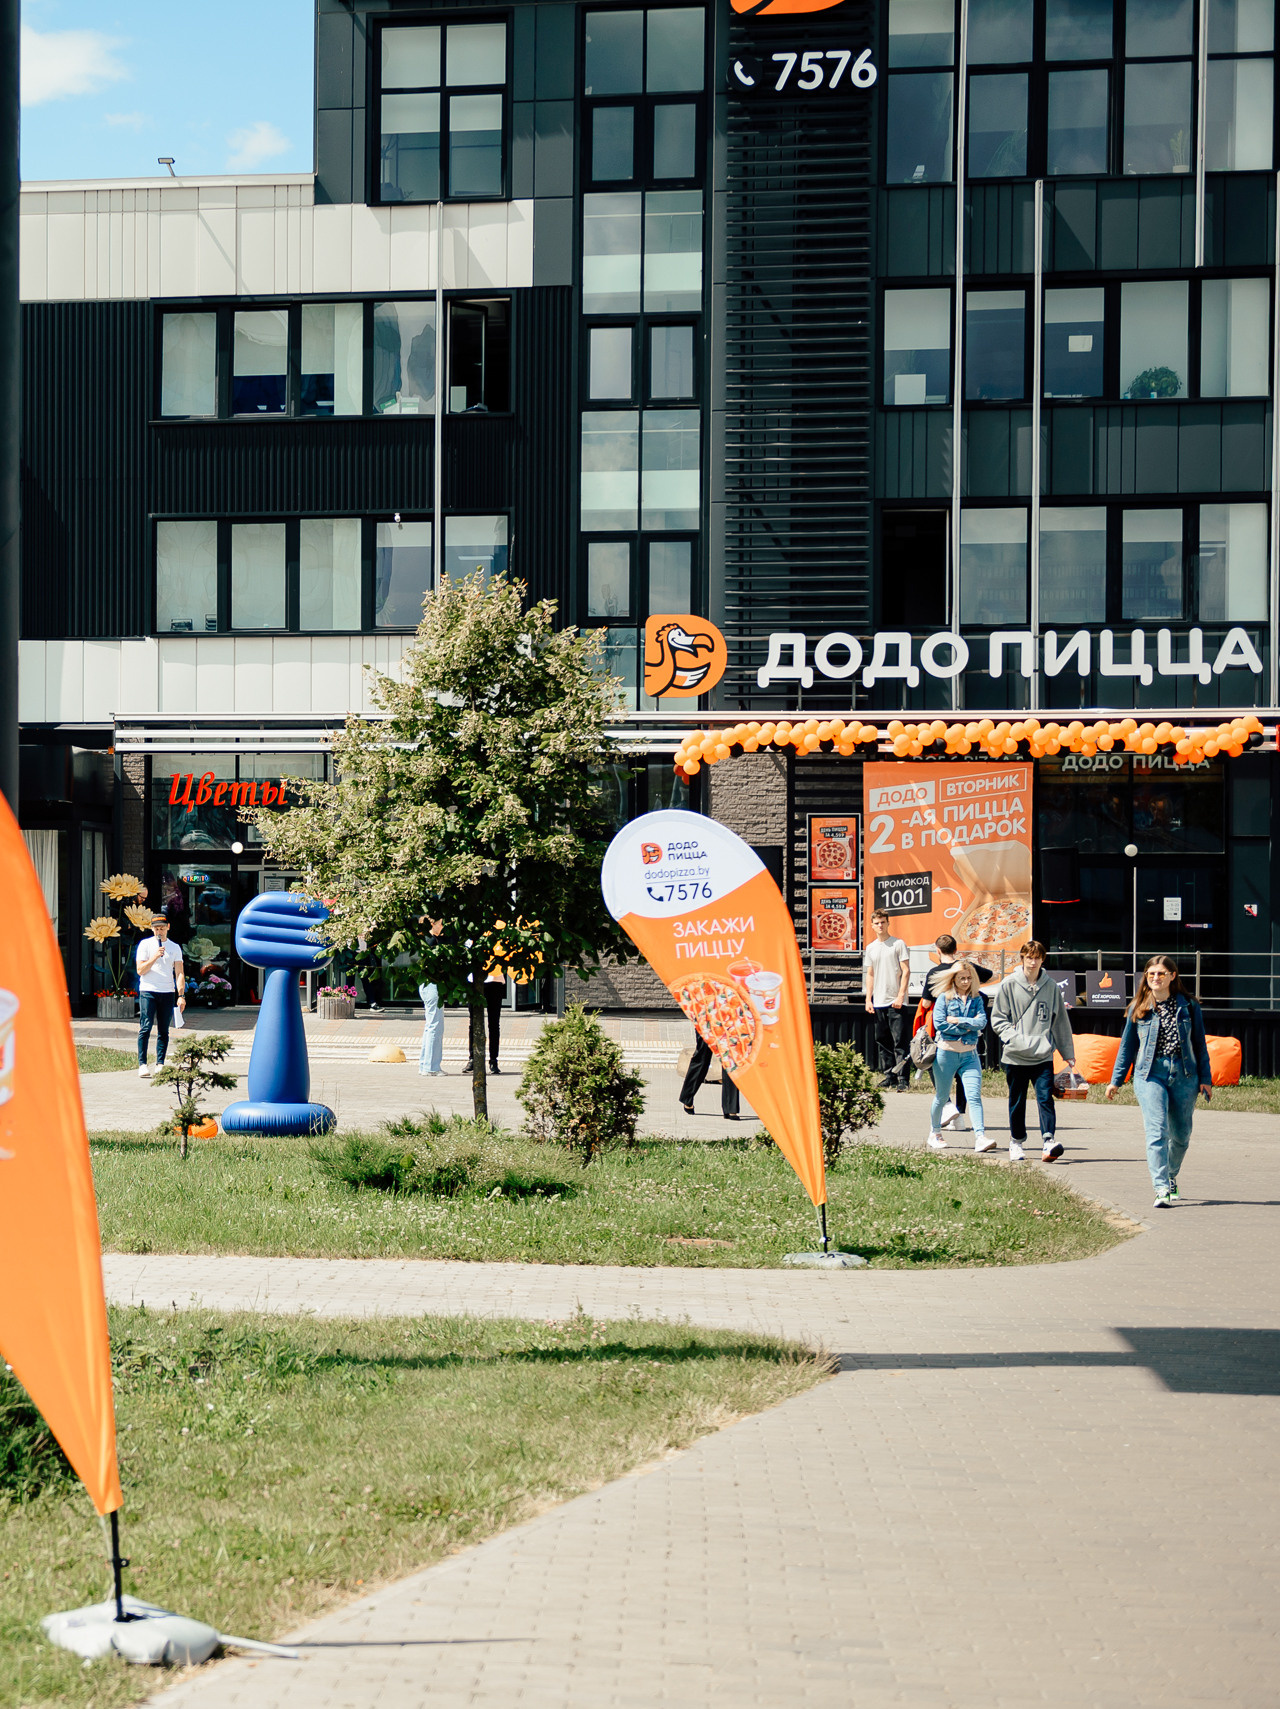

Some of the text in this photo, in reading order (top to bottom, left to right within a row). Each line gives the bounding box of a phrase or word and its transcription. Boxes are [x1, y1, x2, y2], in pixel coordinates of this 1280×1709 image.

[772, 48, 878, 91] 7576
[757, 627, 1264, 689] ДОДО ПИЦЦА
[1062, 755, 1123, 772] ДОДО
[169, 771, 288, 813] Цветы
[877, 774, 1020, 808] ДОДО ВТОРНИК
[943, 797, 1024, 823] ПИЦЦА
[901, 817, 1027, 850] В ПОДАРОК
[668, 841, 698, 851] ДОДО
[668, 851, 708, 861] ПИЦЦА
[644, 866, 710, 880] dodopizza.by
[878, 875, 930, 889] ПРОМОКОД
[665, 882, 713, 902] 7576
[881, 888, 924, 908] 1001
[673, 916, 755, 938] ЗАКАЖИ
[675, 938, 745, 959] ПИЦЦУ
